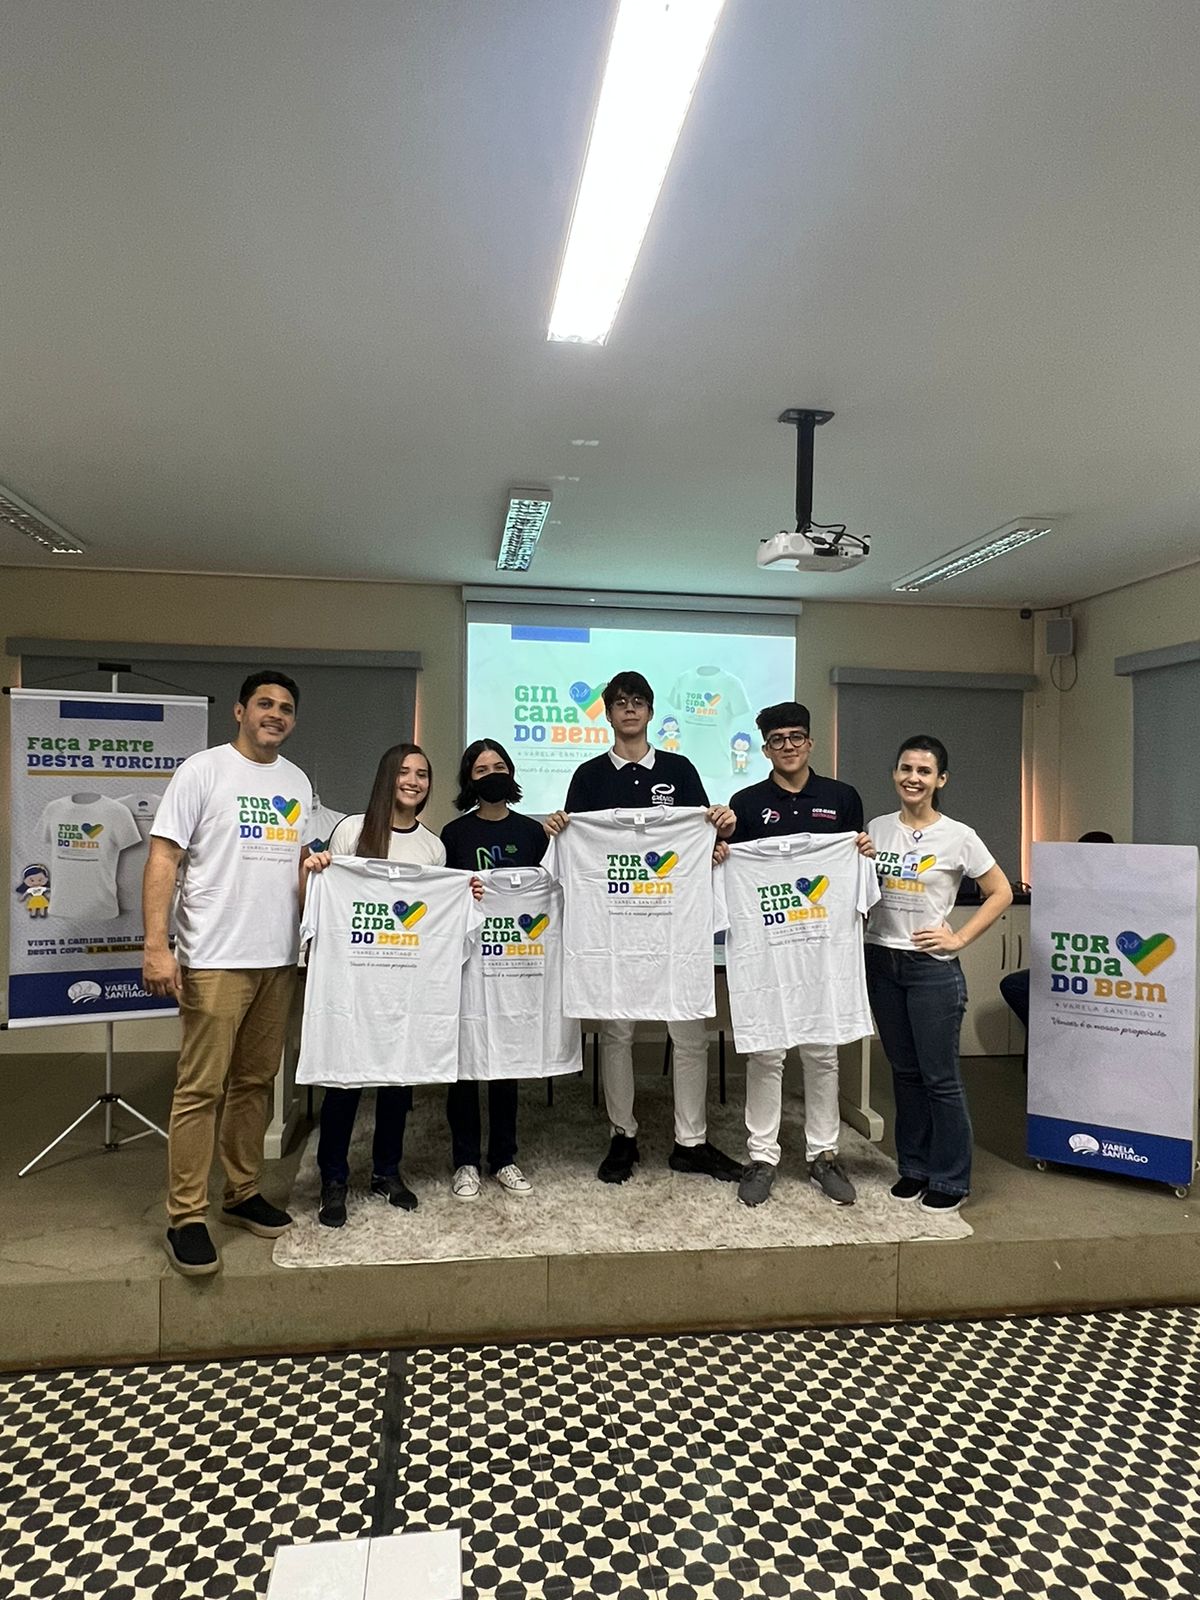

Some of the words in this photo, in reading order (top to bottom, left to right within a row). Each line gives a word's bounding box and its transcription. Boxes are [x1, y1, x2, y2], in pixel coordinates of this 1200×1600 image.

[514, 725, 546, 742] DO
[237, 796, 271, 810] TOR
[240, 825, 262, 838] DO
[58, 839, 70, 847] DO
[607, 854, 641, 867] TOR
[877, 852, 900, 863] OR
[608, 882, 629, 894] DO
[757, 883, 793, 899] TOR
[352, 902, 389, 916] TOR
[484, 917, 515, 929] TOR
[763, 912, 786, 926] DO
[351, 931, 374, 944] DO
[1051, 932, 1110, 954] TOR
[482, 944, 503, 956] DO
[104, 984, 139, 993] VARELA
[1051, 974, 1088, 995] DO
[1062, 1002, 1099, 1012] VARELA
[1103, 1006, 1154, 1018] SANTIAGO
[1102, 1142, 1135, 1155] VARELA
[1102, 1149, 1149, 1164] SANTIAGO
